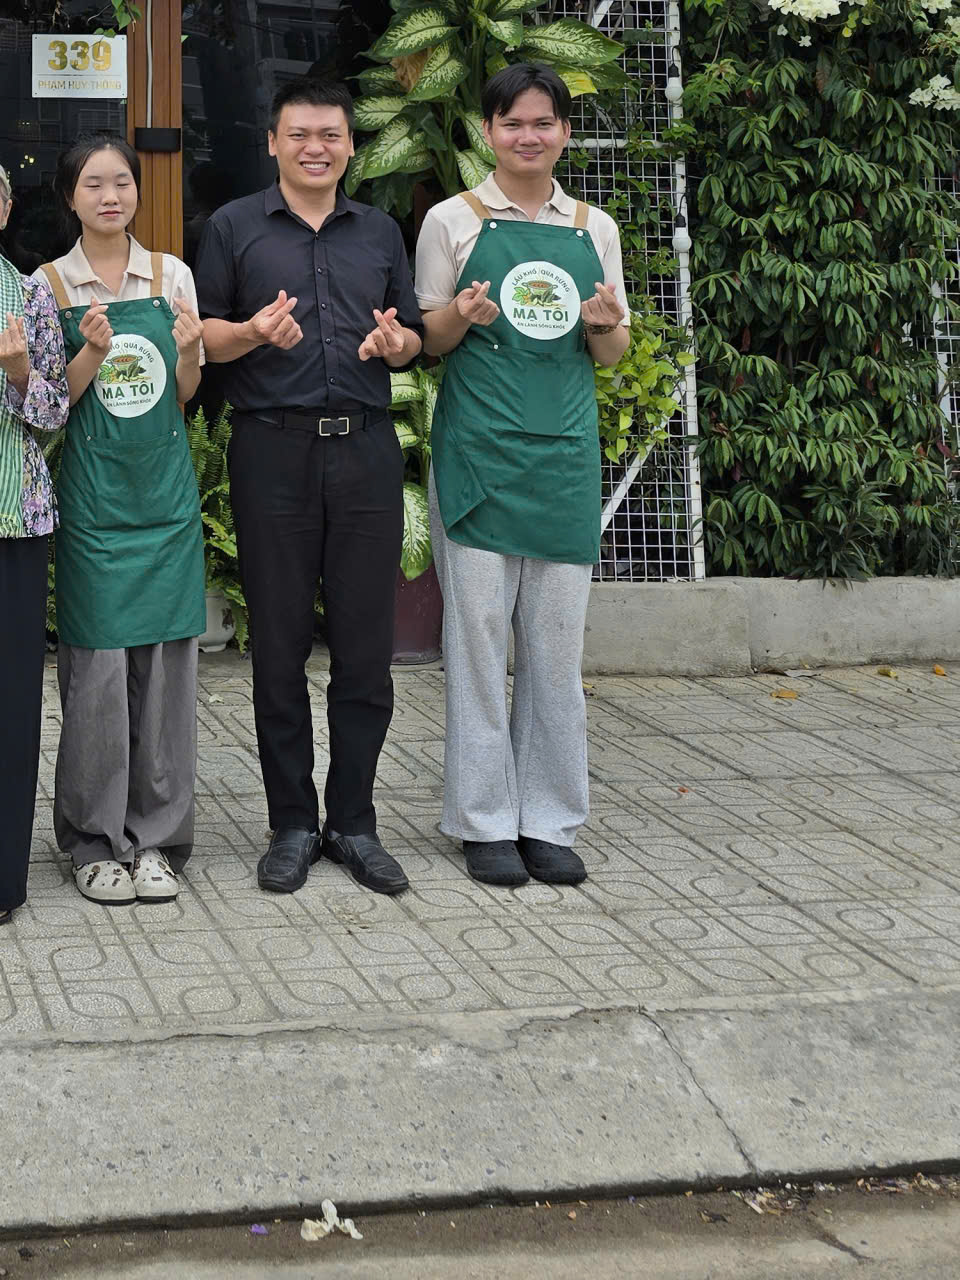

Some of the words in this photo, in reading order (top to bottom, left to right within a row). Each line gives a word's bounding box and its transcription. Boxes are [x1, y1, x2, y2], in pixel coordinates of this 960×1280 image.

[48, 40, 111, 71] 339
[68, 81, 88, 90] HUY
[513, 307, 537, 321] MẠ
[543, 307, 569, 322] TÔI
[102, 386, 125, 400] MẠ
[129, 380, 154, 396] TÔI
